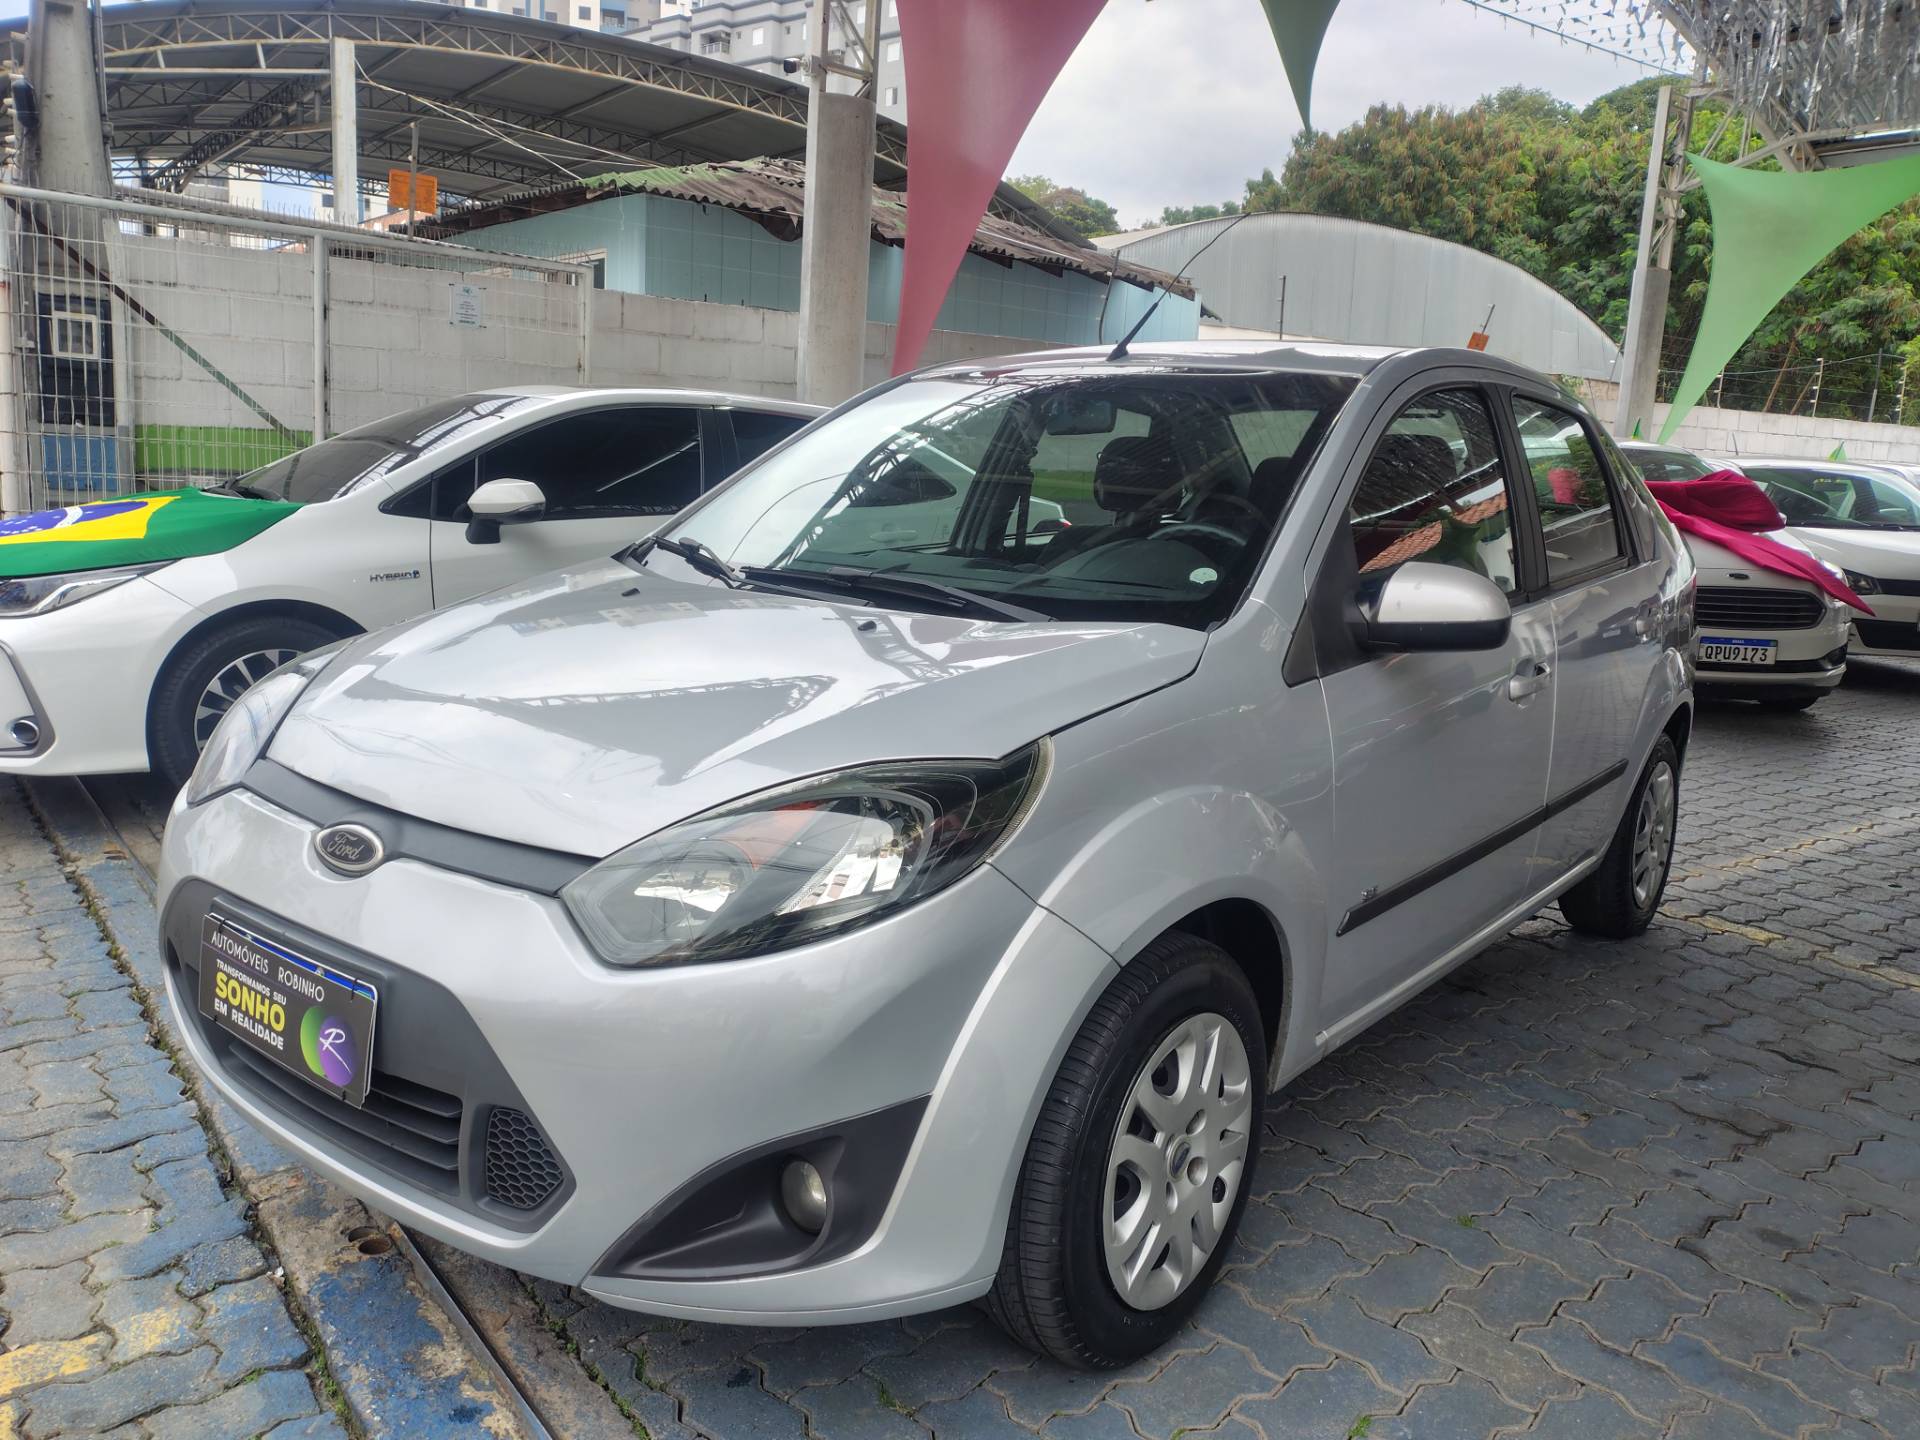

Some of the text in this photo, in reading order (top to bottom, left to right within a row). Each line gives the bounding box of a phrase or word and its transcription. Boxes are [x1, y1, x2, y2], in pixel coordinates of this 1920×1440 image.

[1705, 645, 1768, 662] QPU9I73
[327, 831, 365, 860] Ford
[211, 931, 325, 1002] AUTOMÓVEIS ROBINHO
[215, 971, 285, 1032] SONHO
[273, 991, 287, 1006] SEU
[214, 998, 284, 1051] EM REALIDADE
[319, 1027, 351, 1074] R
